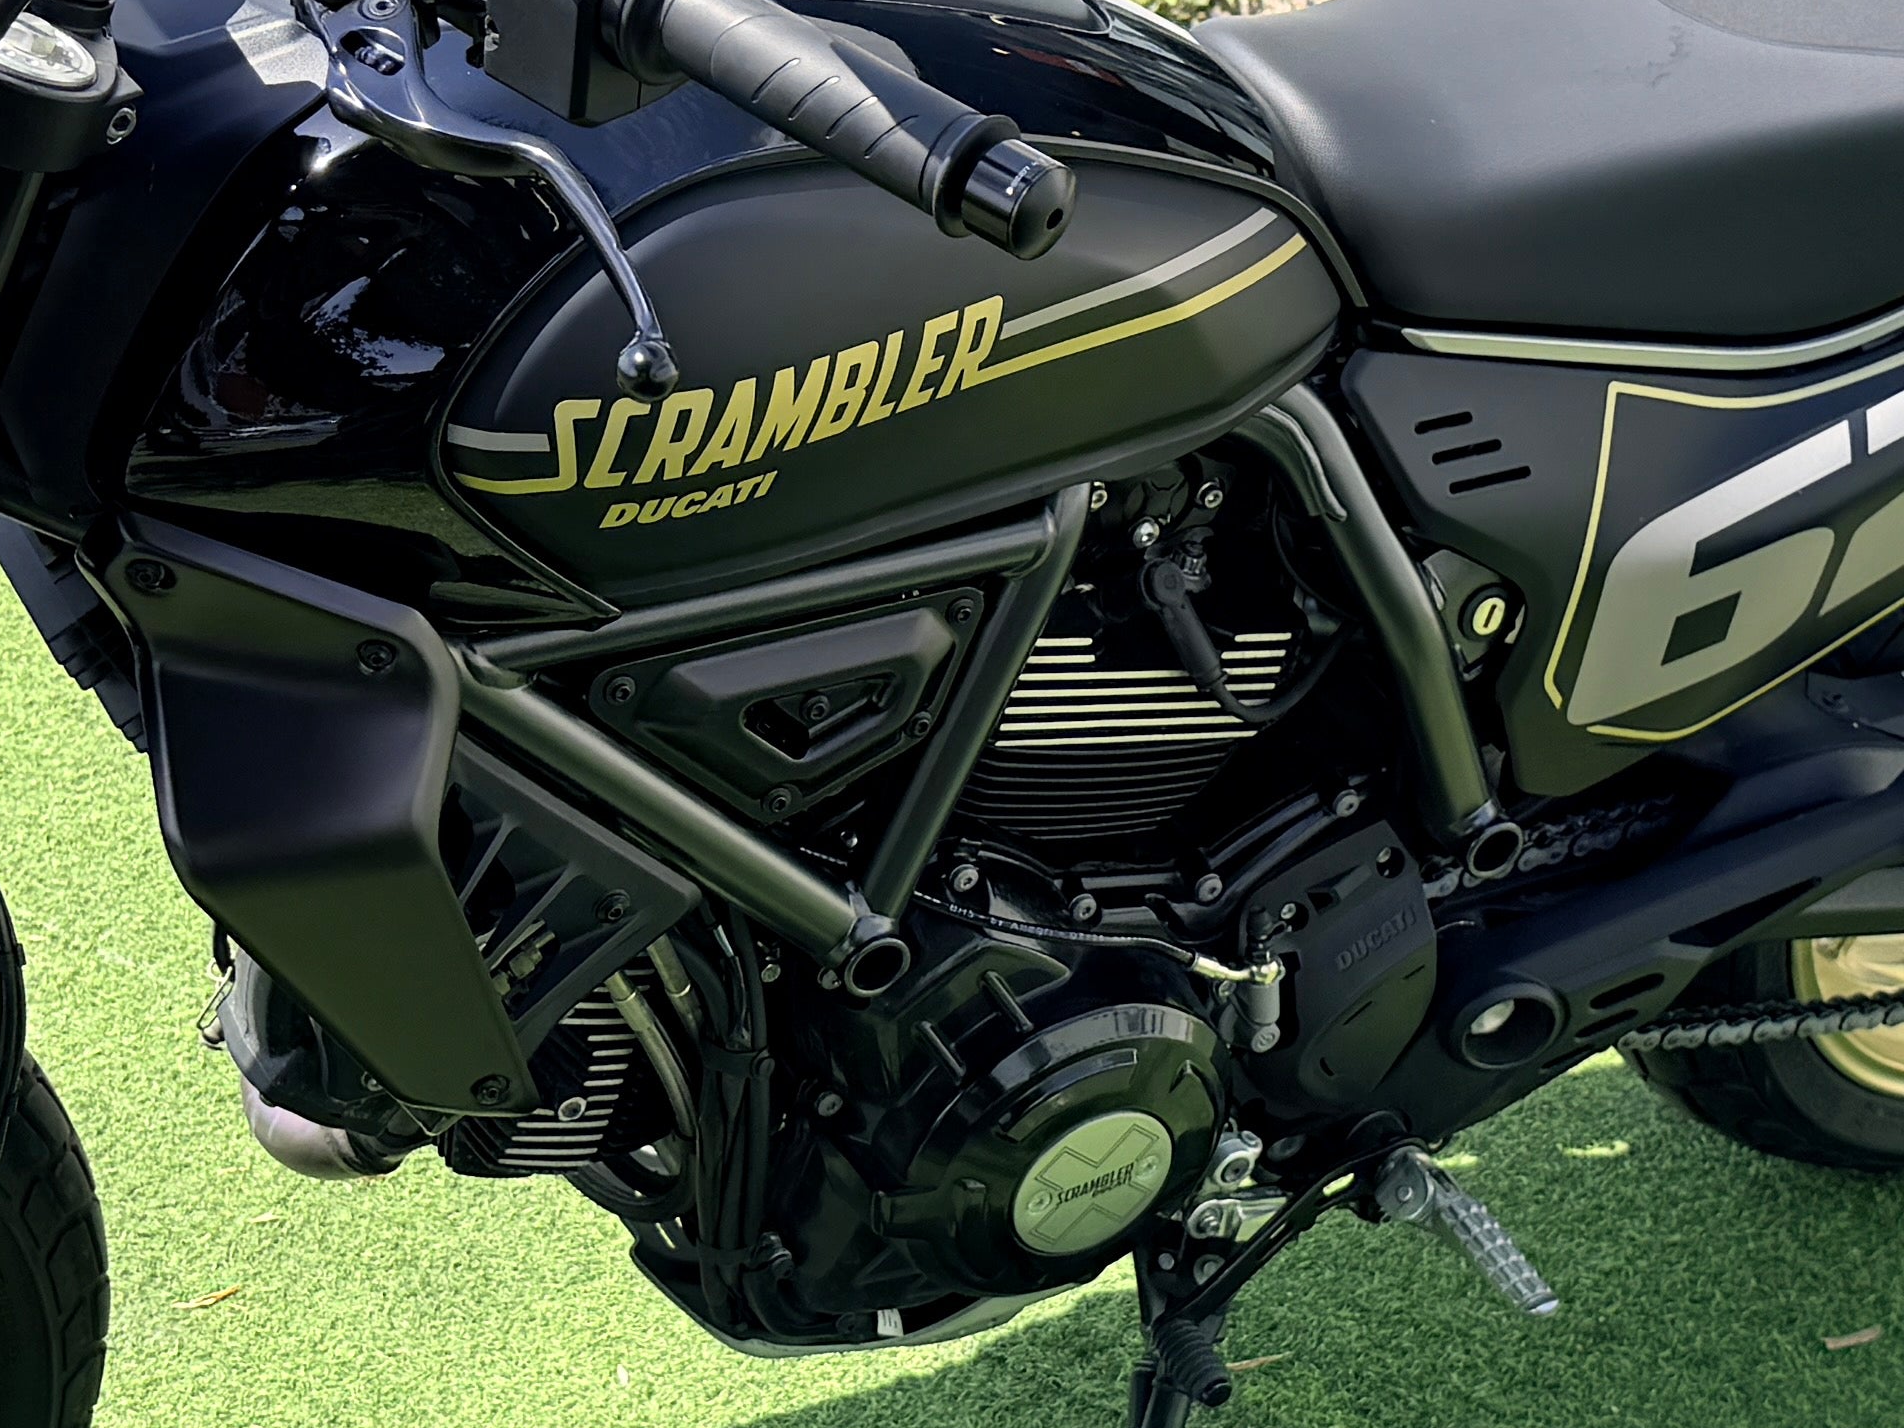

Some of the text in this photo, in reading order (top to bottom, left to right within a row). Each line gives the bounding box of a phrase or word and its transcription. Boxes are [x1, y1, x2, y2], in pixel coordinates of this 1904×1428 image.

[554, 294, 1004, 492] SCRAMBLER
[598, 470, 778, 529] DUCATI
[1336, 905, 1417, 972] DUCATI
[1056, 1161, 1135, 1206] SCRAMBLER
